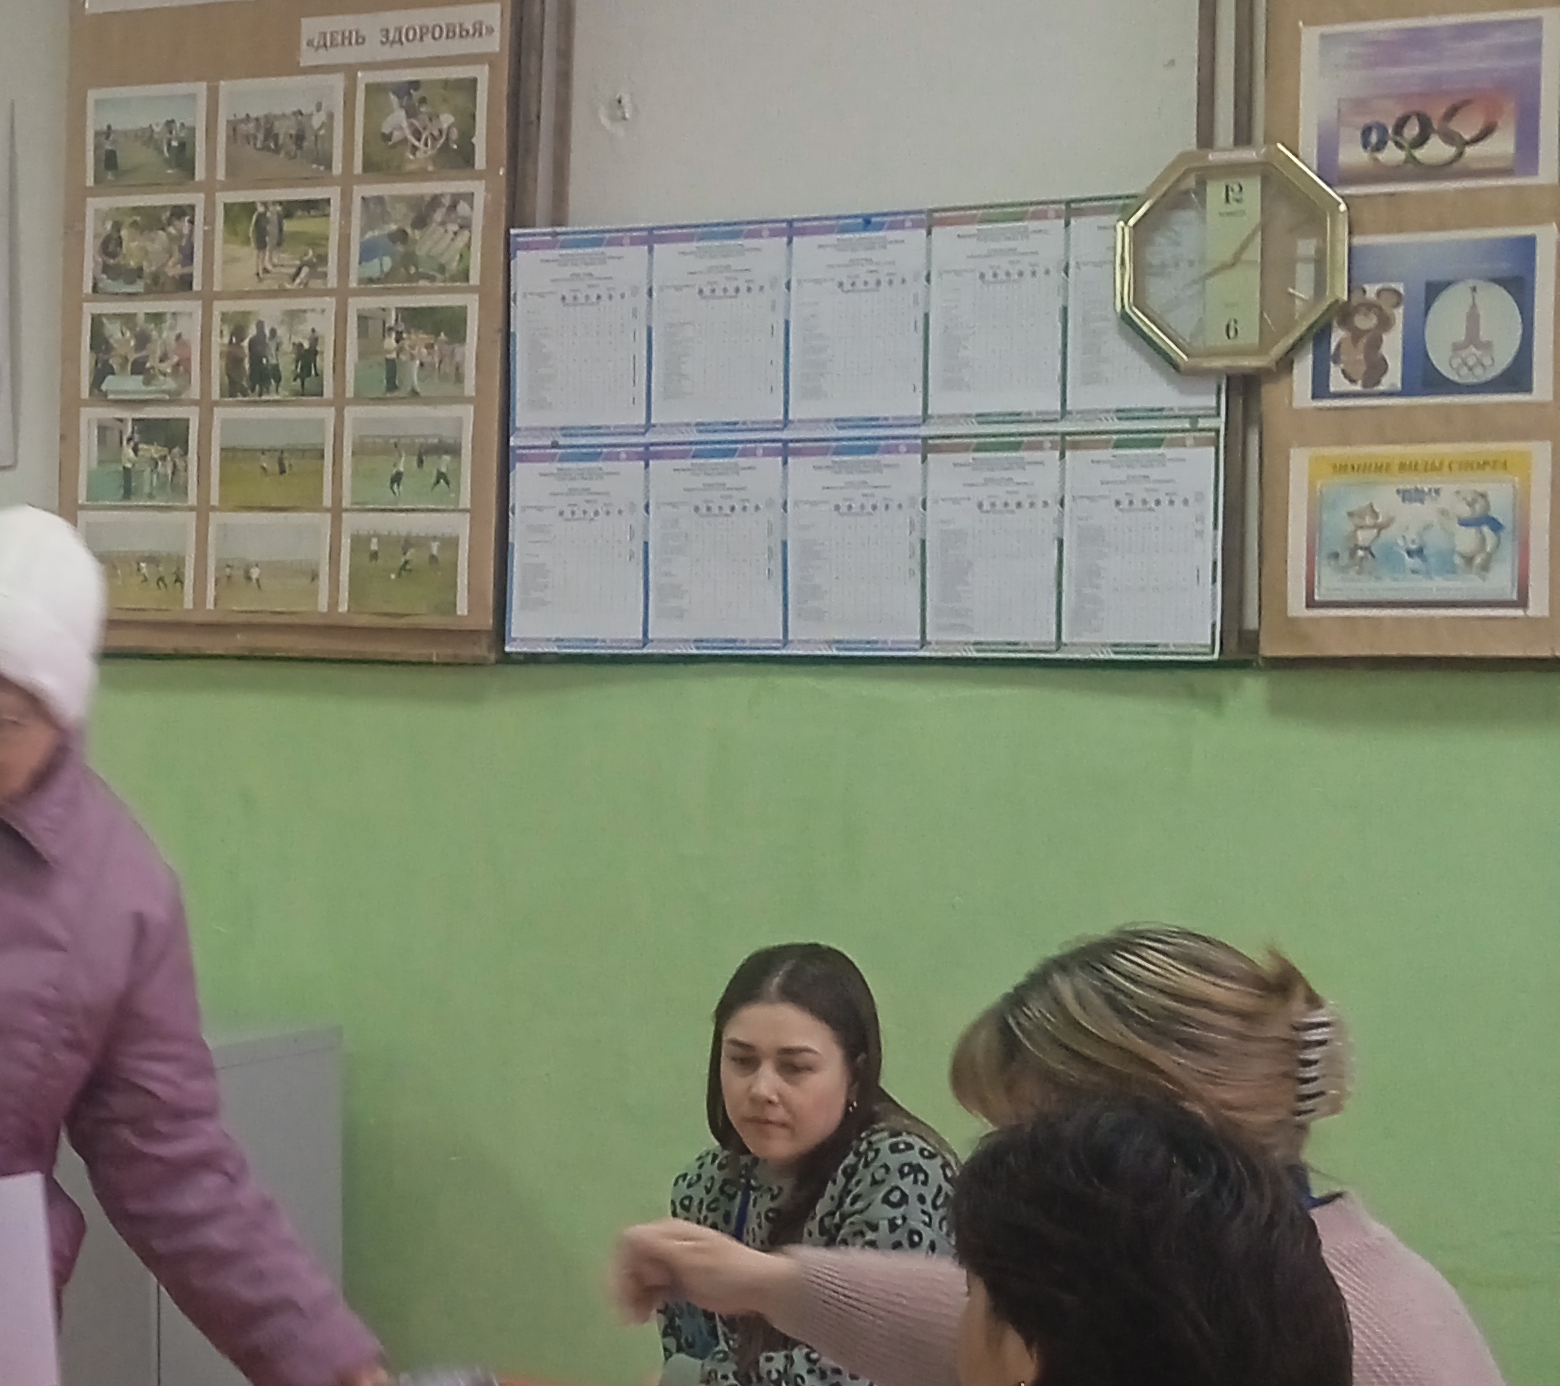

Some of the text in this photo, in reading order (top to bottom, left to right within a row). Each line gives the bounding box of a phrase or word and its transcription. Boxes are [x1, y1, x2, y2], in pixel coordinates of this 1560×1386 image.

[305, 20, 496, 51] «ДЕНЬ ЗДОРОВЬЯ»
[1223, 182, 1244, 205] 12
[1225, 317, 1239, 341] 6
